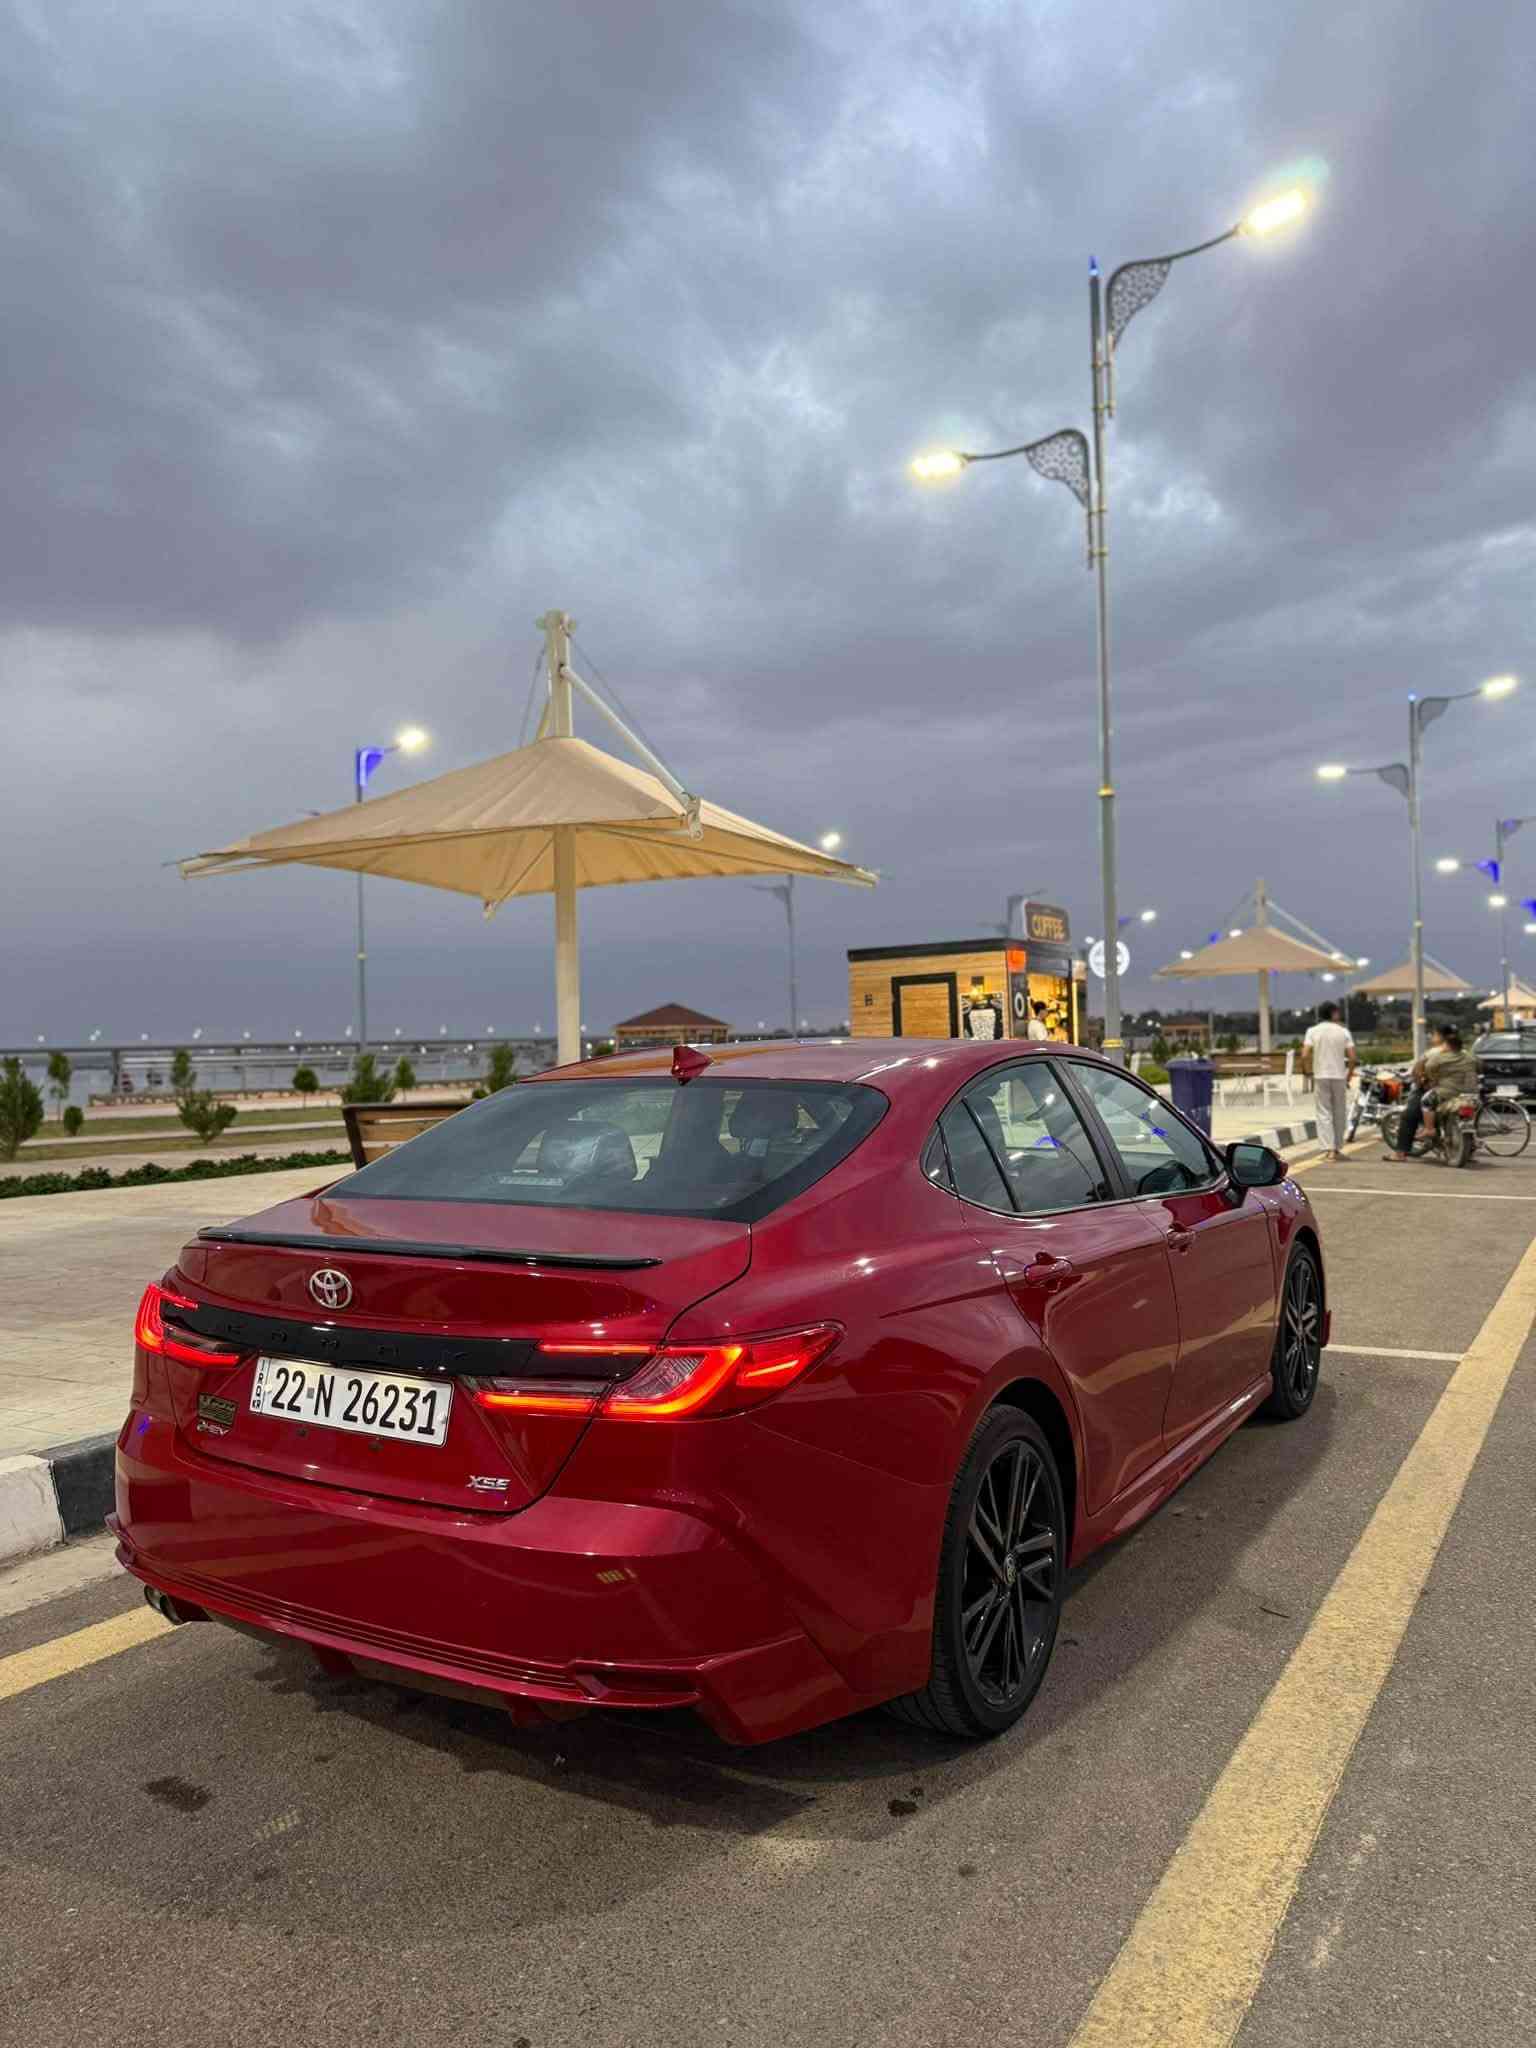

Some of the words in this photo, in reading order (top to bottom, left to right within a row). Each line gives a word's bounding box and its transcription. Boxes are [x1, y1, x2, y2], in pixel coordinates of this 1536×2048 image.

[271, 1367, 306, 1413] 22
[313, 1374, 335, 1418] N
[342, 1378, 438, 1436] 26231
[465, 1475, 511, 1491] XSE
